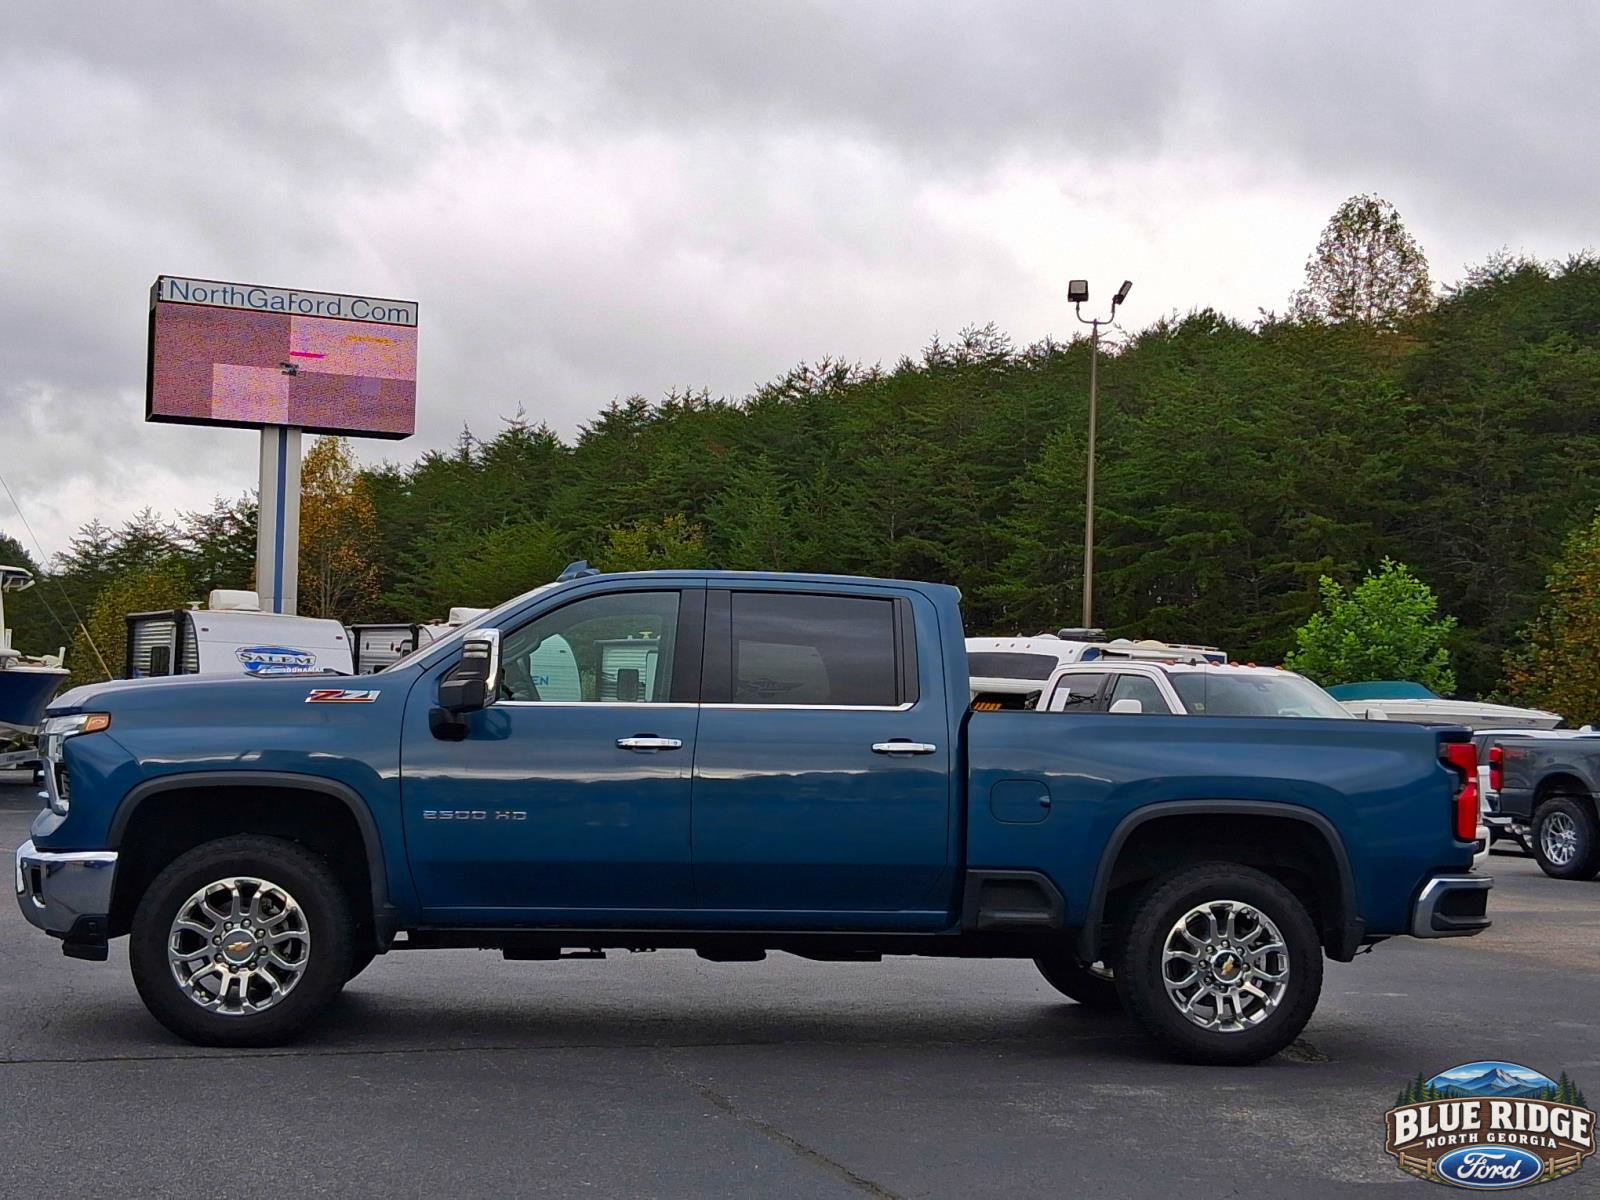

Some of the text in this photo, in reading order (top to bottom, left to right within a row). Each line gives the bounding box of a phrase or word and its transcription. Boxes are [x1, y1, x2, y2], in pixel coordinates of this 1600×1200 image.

[169, 279, 410, 324] NorthGaFord.Com
[240, 652, 312, 665] SALEM
[305, 688, 382, 703] Z71
[422, 809, 528, 821] 2500 HD
